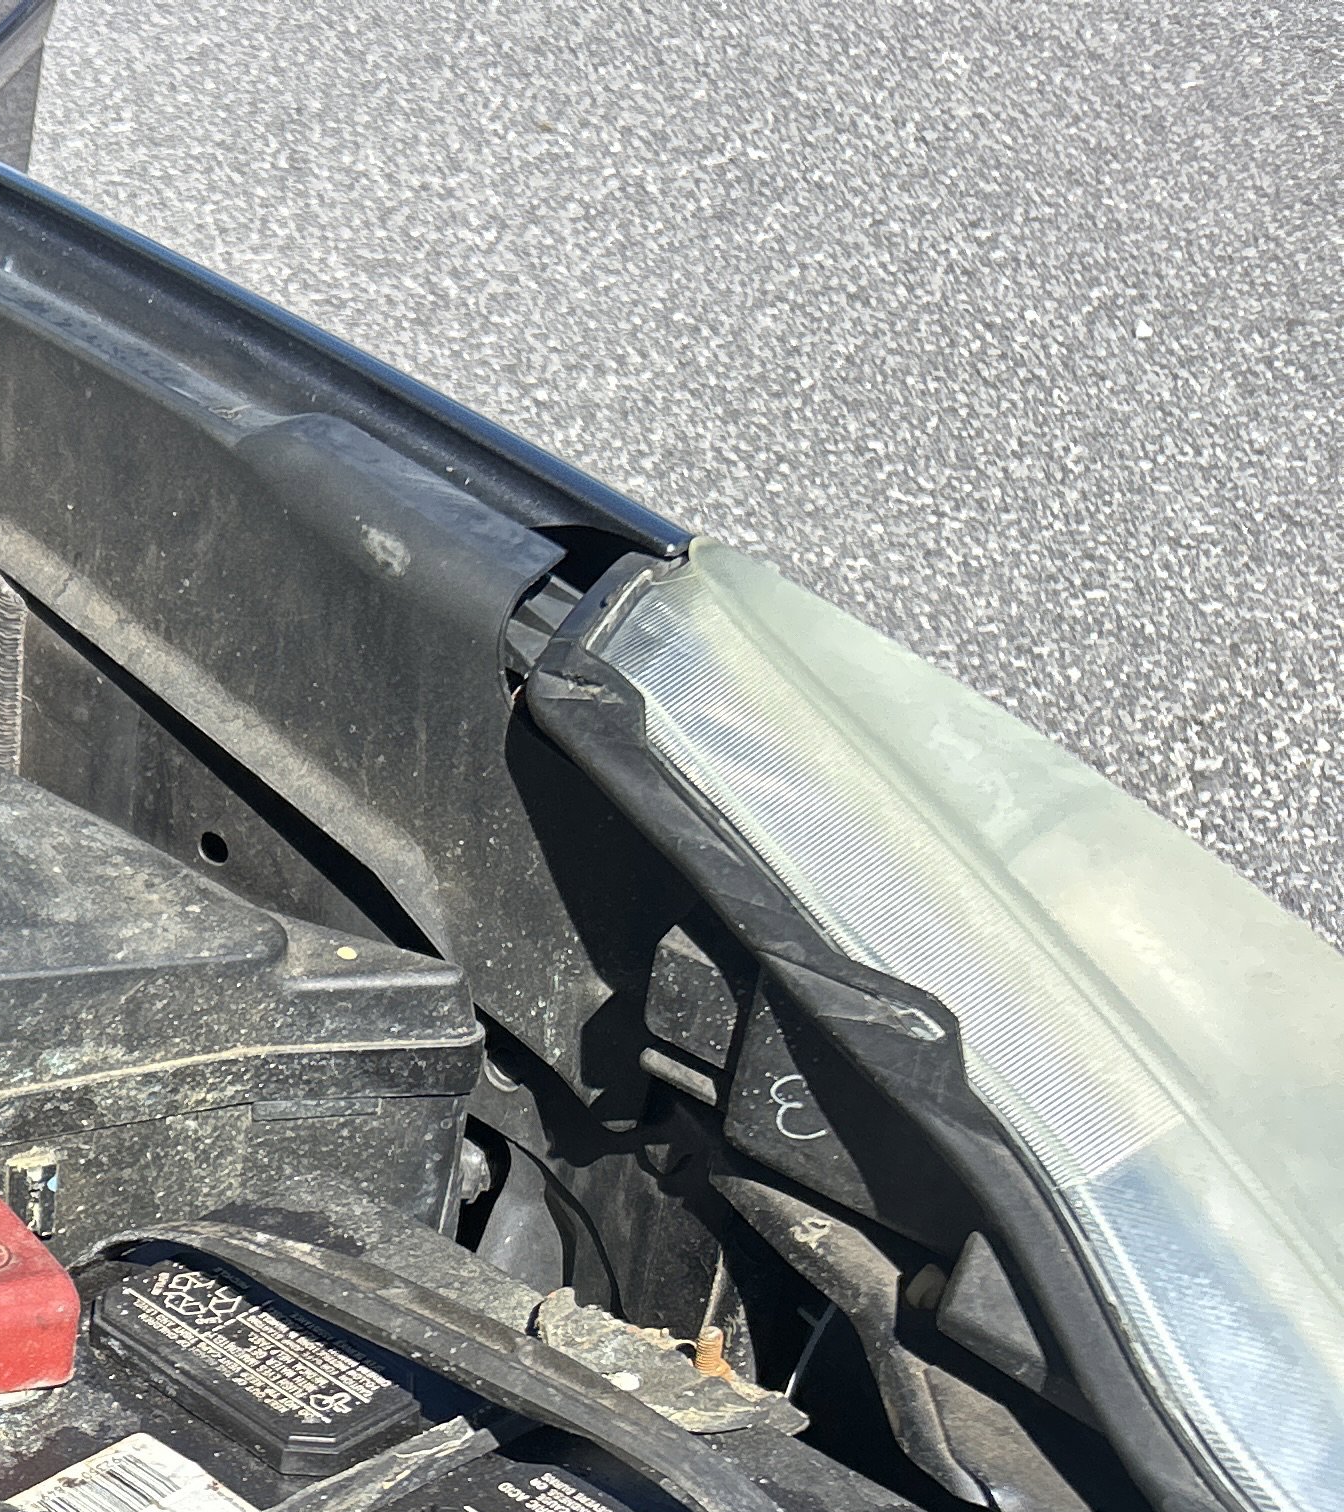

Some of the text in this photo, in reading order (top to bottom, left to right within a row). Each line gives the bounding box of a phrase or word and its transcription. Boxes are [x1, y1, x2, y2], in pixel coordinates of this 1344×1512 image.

[495, 1480, 530, 1503] ACID
[528, 1477, 549, 1491] OR
[539, 1471, 576, 1495] BURNS
